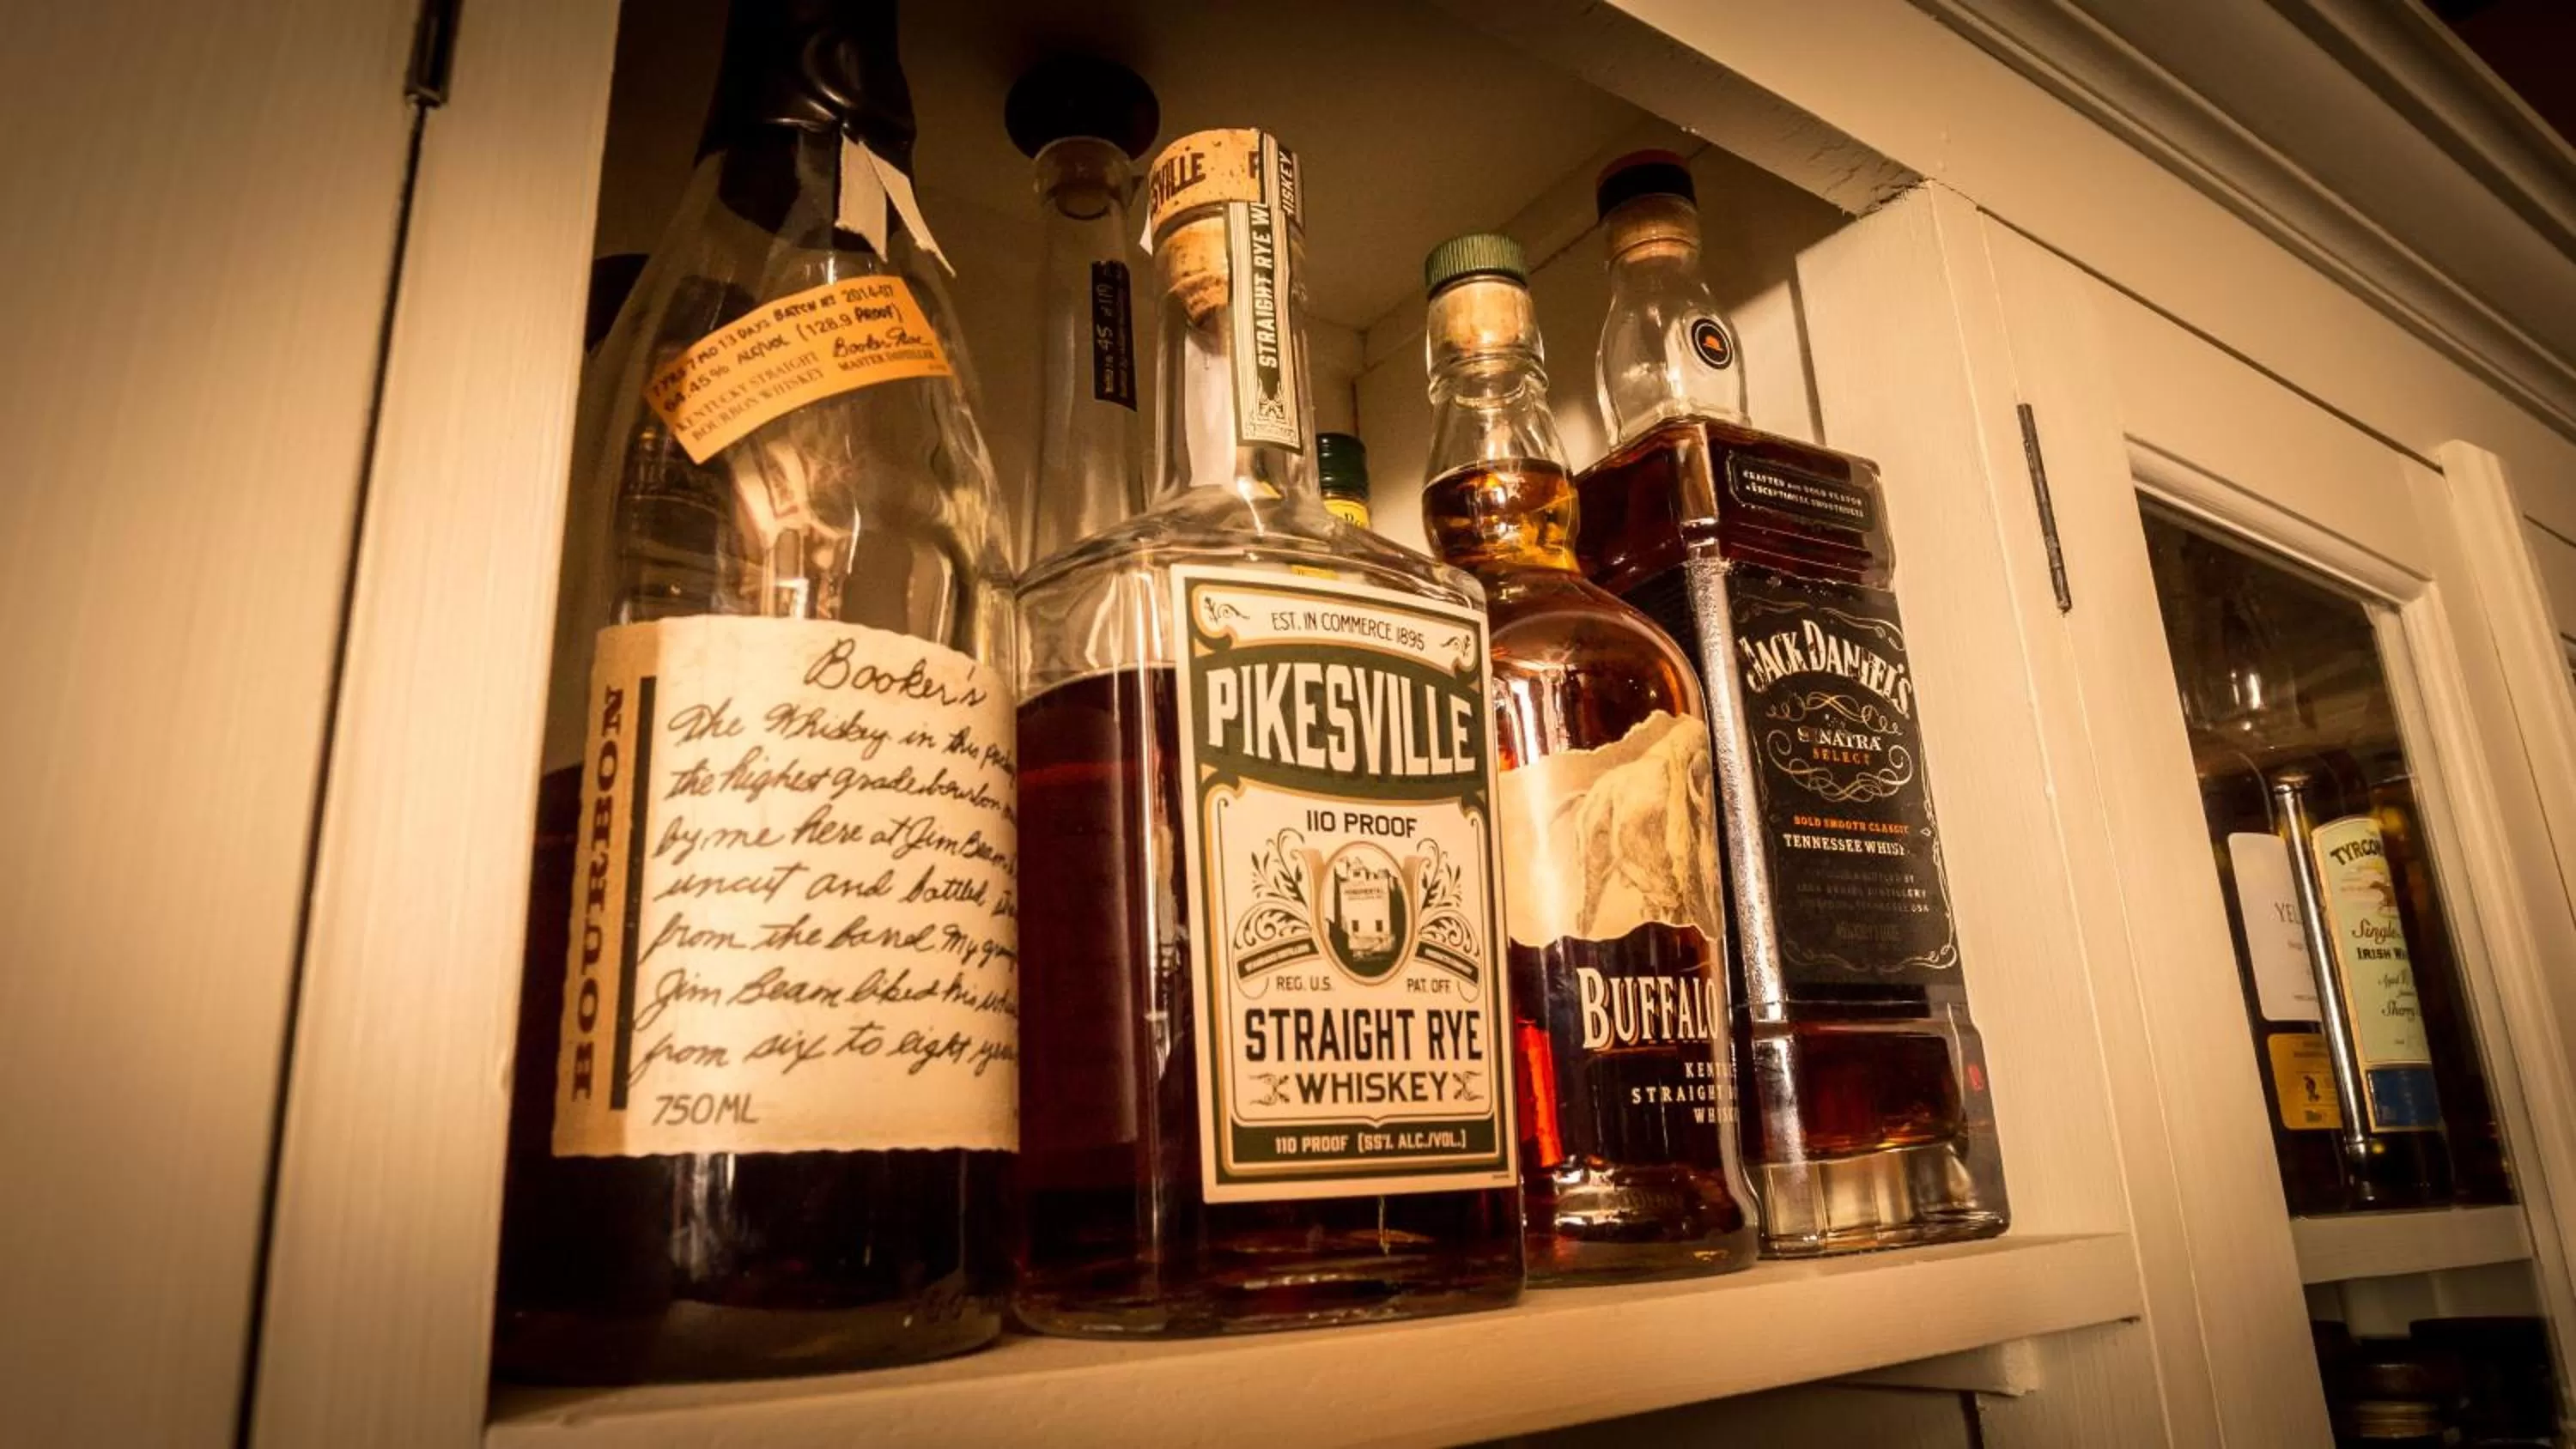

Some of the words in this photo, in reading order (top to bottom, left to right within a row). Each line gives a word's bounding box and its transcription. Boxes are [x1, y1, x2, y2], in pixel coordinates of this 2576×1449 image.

[1252, 230, 1273, 270] RYE
[1254, 273, 1278, 368] STRAIGHT
[675, 382, 748, 433] KENTUCKY
[749, 350, 820, 386] STRAIGHT
[690, 397, 760, 441] BOURBON
[759, 367, 825, 400] WHISKEY
[1271, 611, 1302, 631] EST.
[1303, 611, 1318, 631] IN
[1321, 612, 1393, 641] COMMERCE
[1395, 627, 1425, 651] 1895
[803, 638, 987, 707] Booker's
[1739, 630, 1809, 693] JACK
[1801, 618, 1912, 720] DANIEL'S
[667, 698, 746, 748] The
[898, 722, 937, 749] in
[1206, 662, 1476, 776] PIKESVILLE
[1797, 727, 1883, 751] SNATRA
[664, 757, 714, 800] the
[719, 745, 832, 804] highest
[1813, 747, 1870, 767] SELECT
[791, 803, 864, 846] here
[869, 816, 912, 846] at
[891, 815, 959, 861] Jim
[1306, 809, 1336, 833] 110
[1344, 810, 1419, 838] PROOF
[1783, 833, 1862, 852] TENNESSEE
[1794, 815, 1821, 828] BOLD
[1823, 818, 1867, 832] SMOOTH
[571, 684, 624, 1102] BOURBON
[653, 861, 810, 903] uncut
[805, 869, 894, 900] and
[635, 912, 747, 965] from
[750, 912, 823, 951] the
[2351, 917, 2396, 945] Single
[2357, 947, 2391, 961] IRISH
[631, 967, 723, 1032] Jim
[726, 967, 845, 1008] Beam
[844, 968, 940, 1007] liked
[1276, 975, 1306, 991] REG.
[1310, 976, 1334, 991] U.S.
[1577, 967, 1718, 1050] BUFFALO
[627, 1032, 730, 1087] from
[743, 1029, 826, 1074] six
[834, 1020, 884, 1057] to
[885, 1026, 972, 1076] eight
[1244, 1008, 1416, 1063] STRAIGHT
[1425, 1008, 1484, 1062] RYE
[651, 1093, 760, 1125] 750ML
[1295, 1070, 1449, 1105] WHISKEY
[1631, 1085, 1724, 1104] STRAIGHT
[1275, 1136, 1297, 1155] 110
[1302, 1135, 1349, 1153] PROOF
